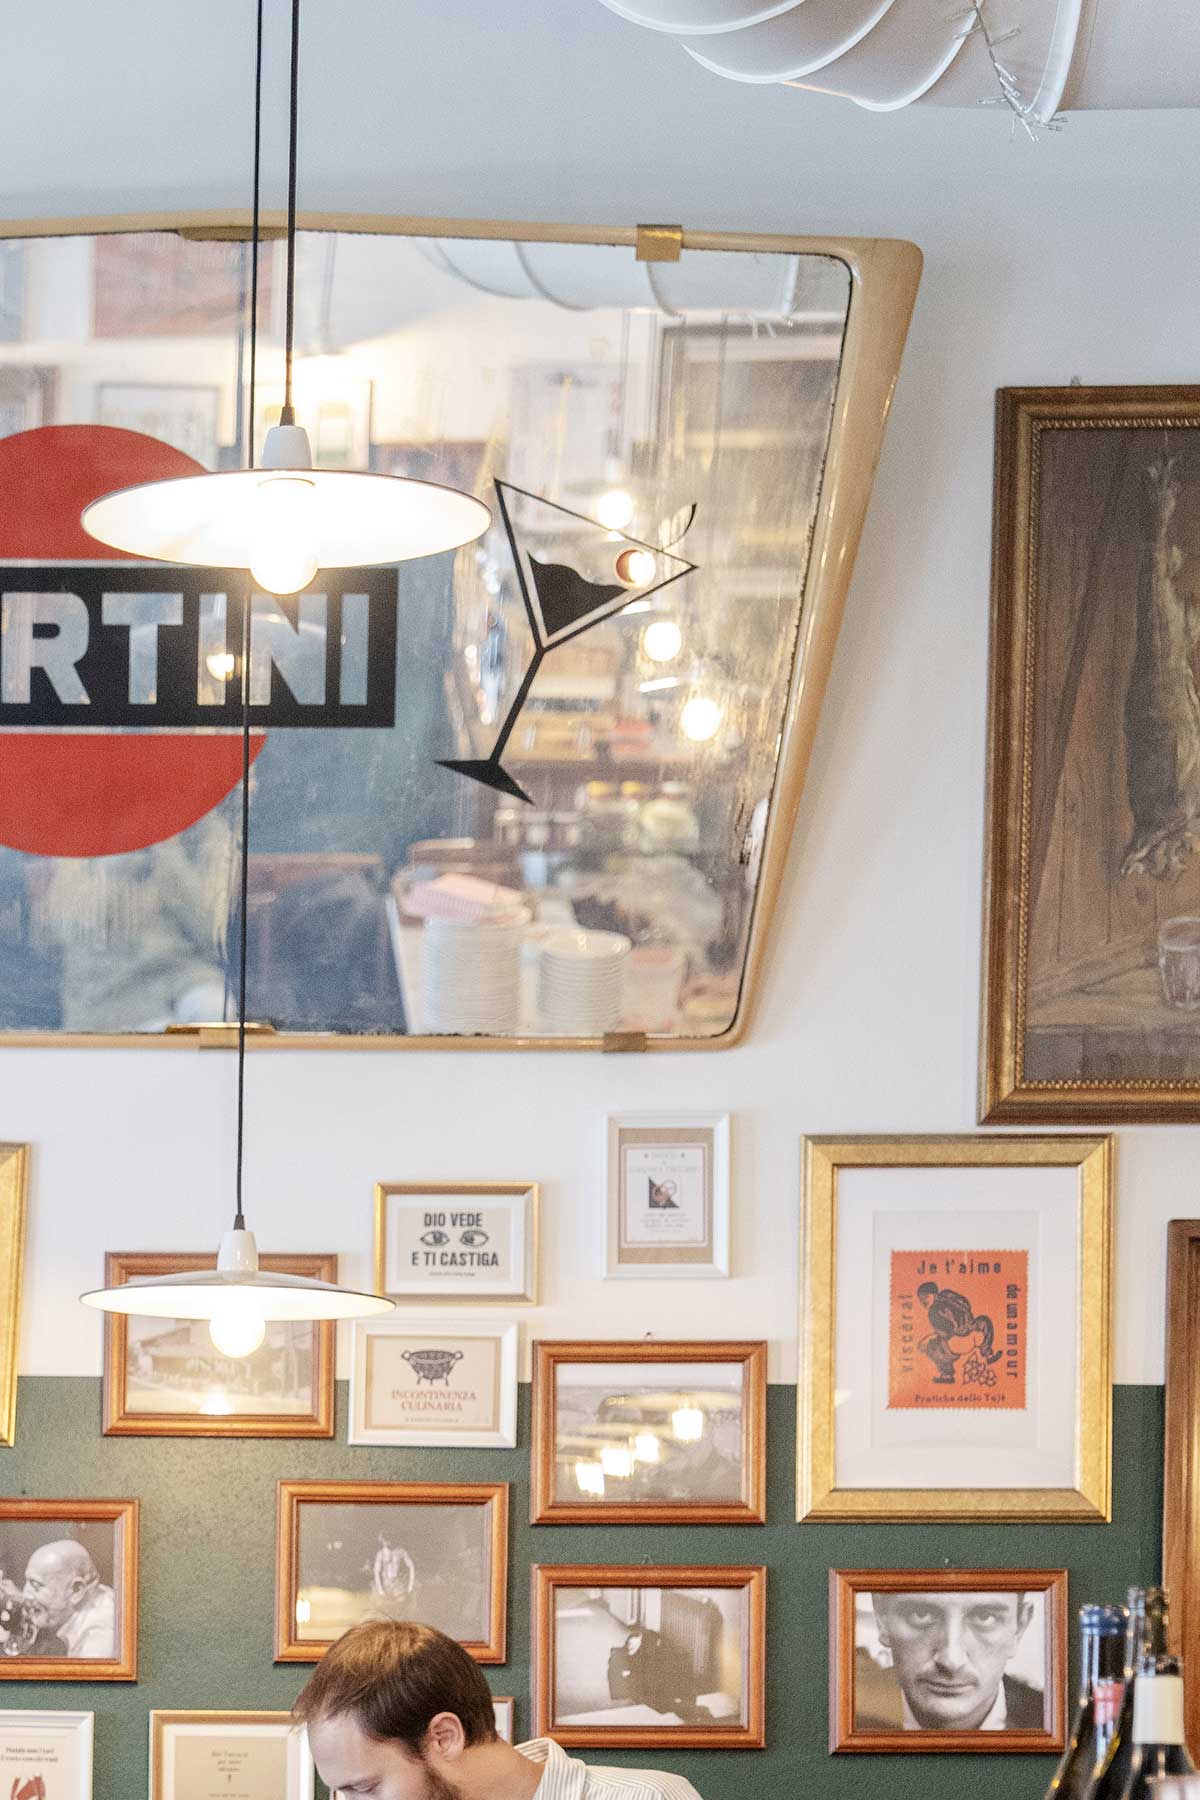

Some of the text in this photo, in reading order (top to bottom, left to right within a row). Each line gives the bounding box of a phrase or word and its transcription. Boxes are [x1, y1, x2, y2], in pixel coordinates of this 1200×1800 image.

[424, 1212, 483, 1227] DIO VEDE
[412, 1251, 499, 1266] E TI CASTIGA
[917, 1259, 937, 1274] Je
